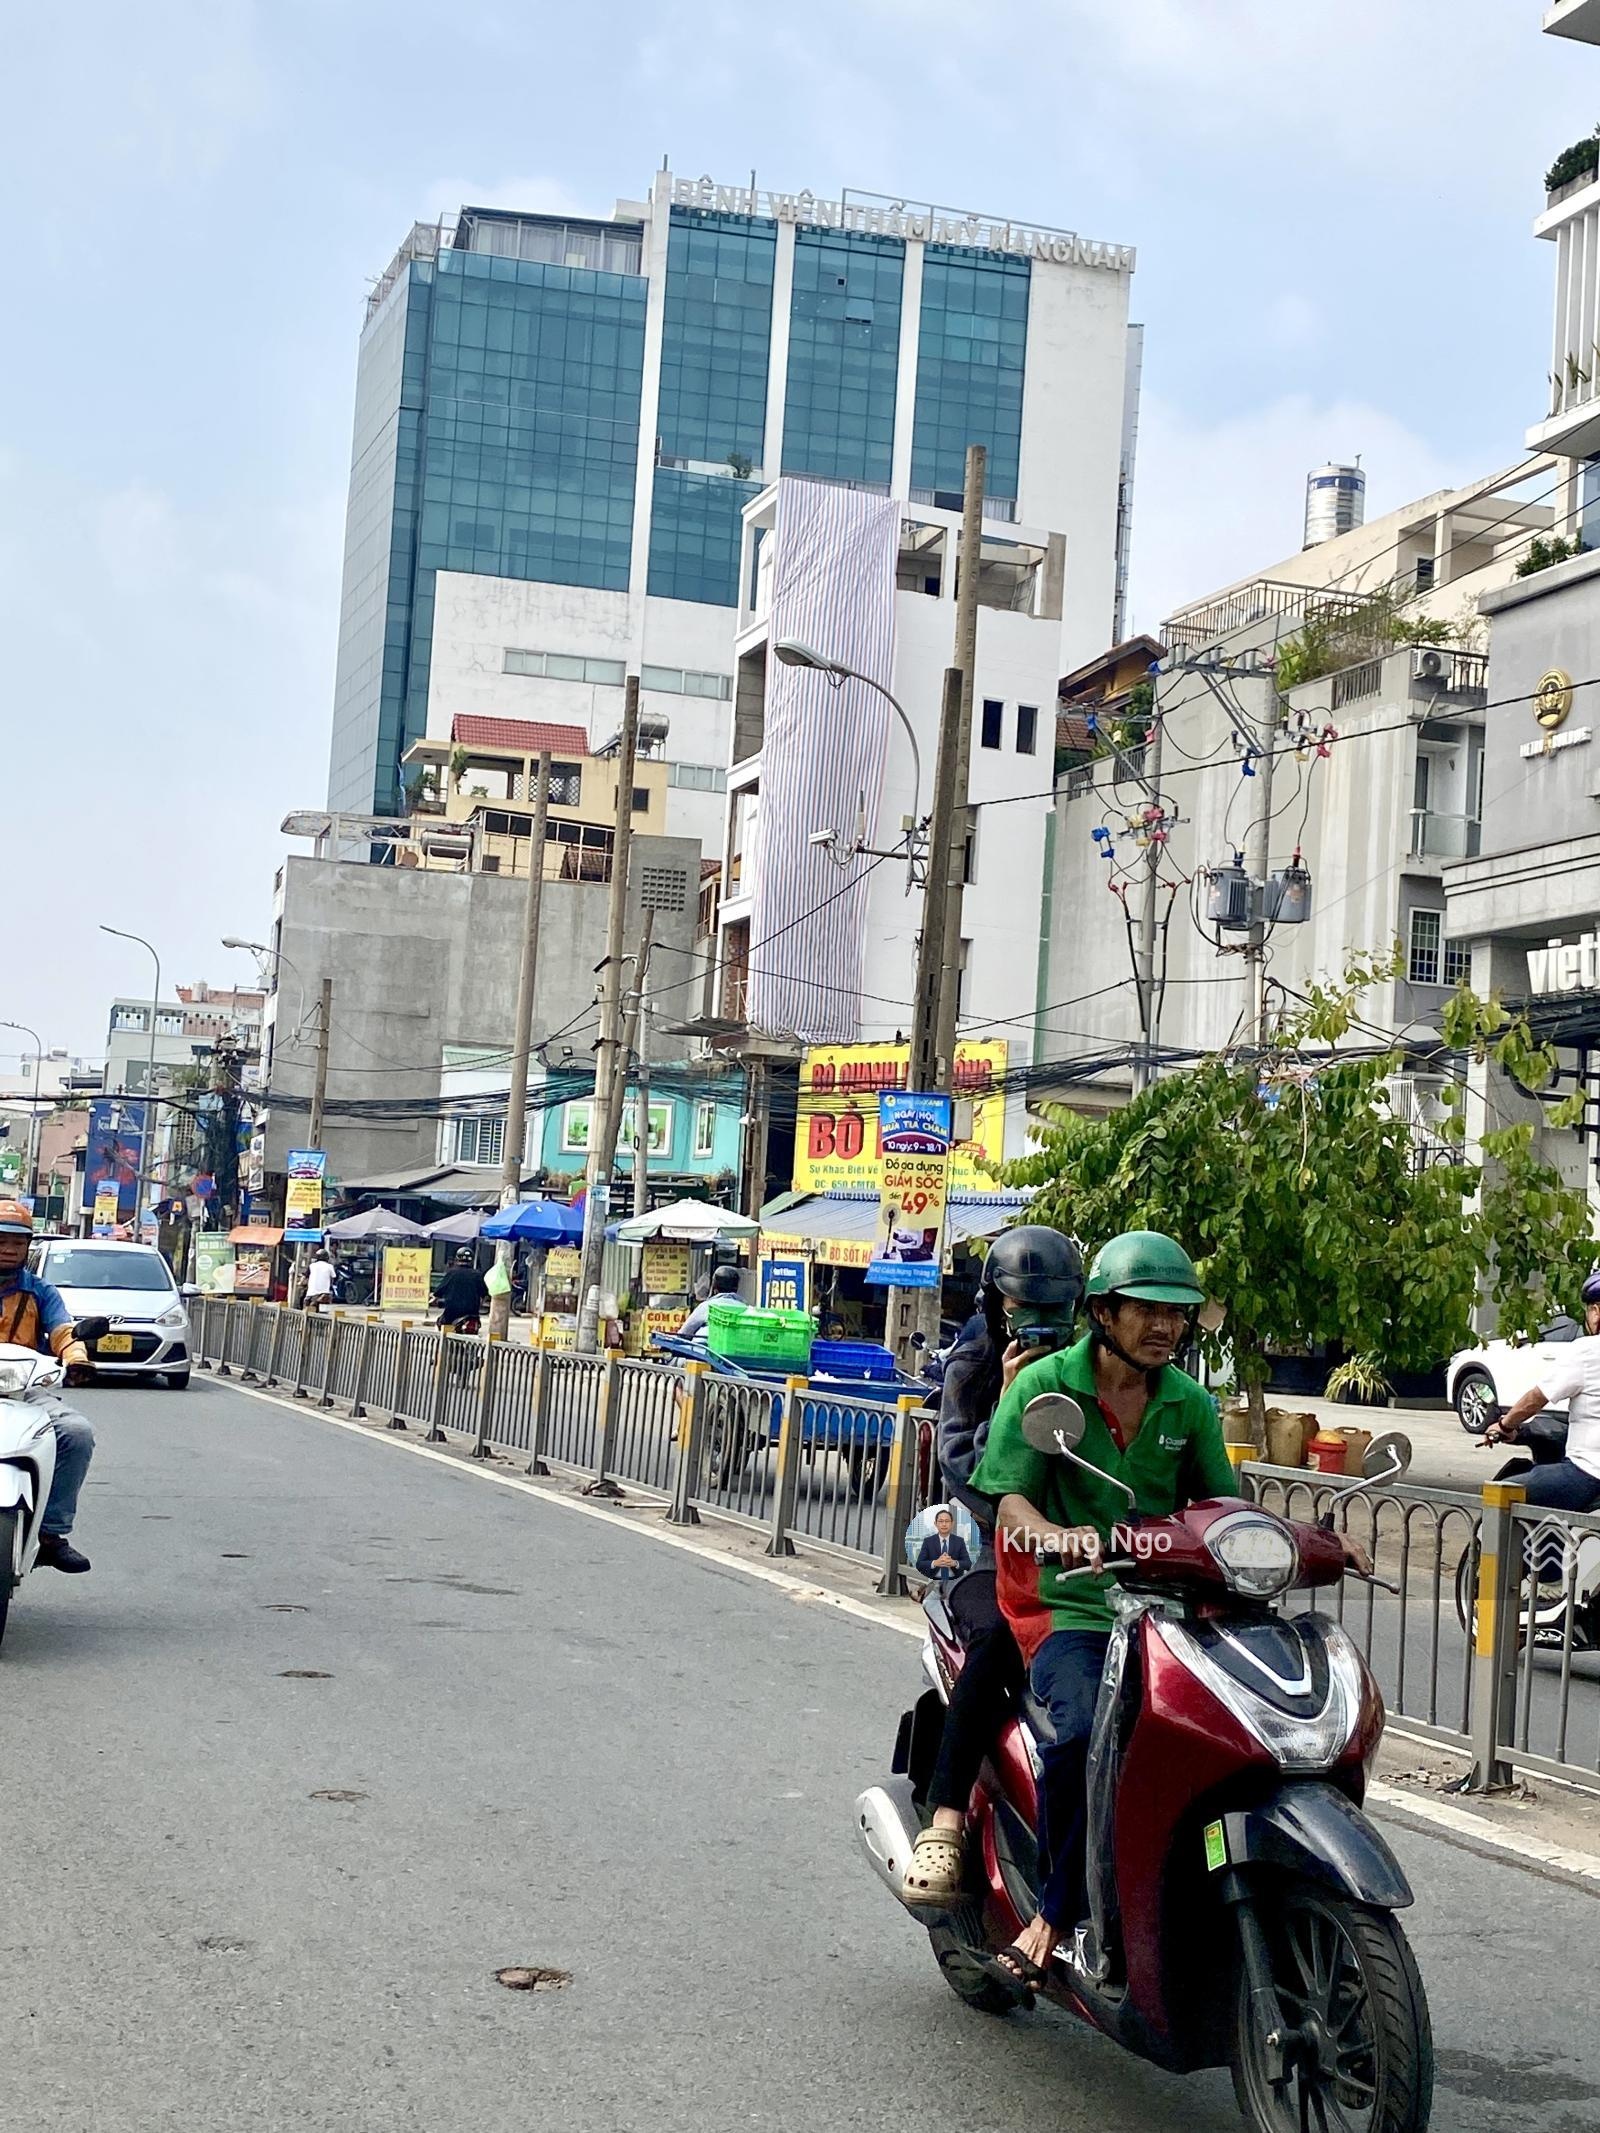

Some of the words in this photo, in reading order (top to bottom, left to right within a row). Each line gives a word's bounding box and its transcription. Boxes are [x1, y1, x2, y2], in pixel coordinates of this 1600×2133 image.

[988, 225, 1137, 273] KANGNAM
[887, 1141, 896, 1149] 10
[913, 1143, 919, 1151] 9
[916, 1161, 943, 1175] dụng
[884, 1170, 912, 1188] GIẢM
[915, 1172, 943, 1189] SỐC
[901, 1191, 940, 1214] 49%
[770, 1280, 797, 1298] BIG
